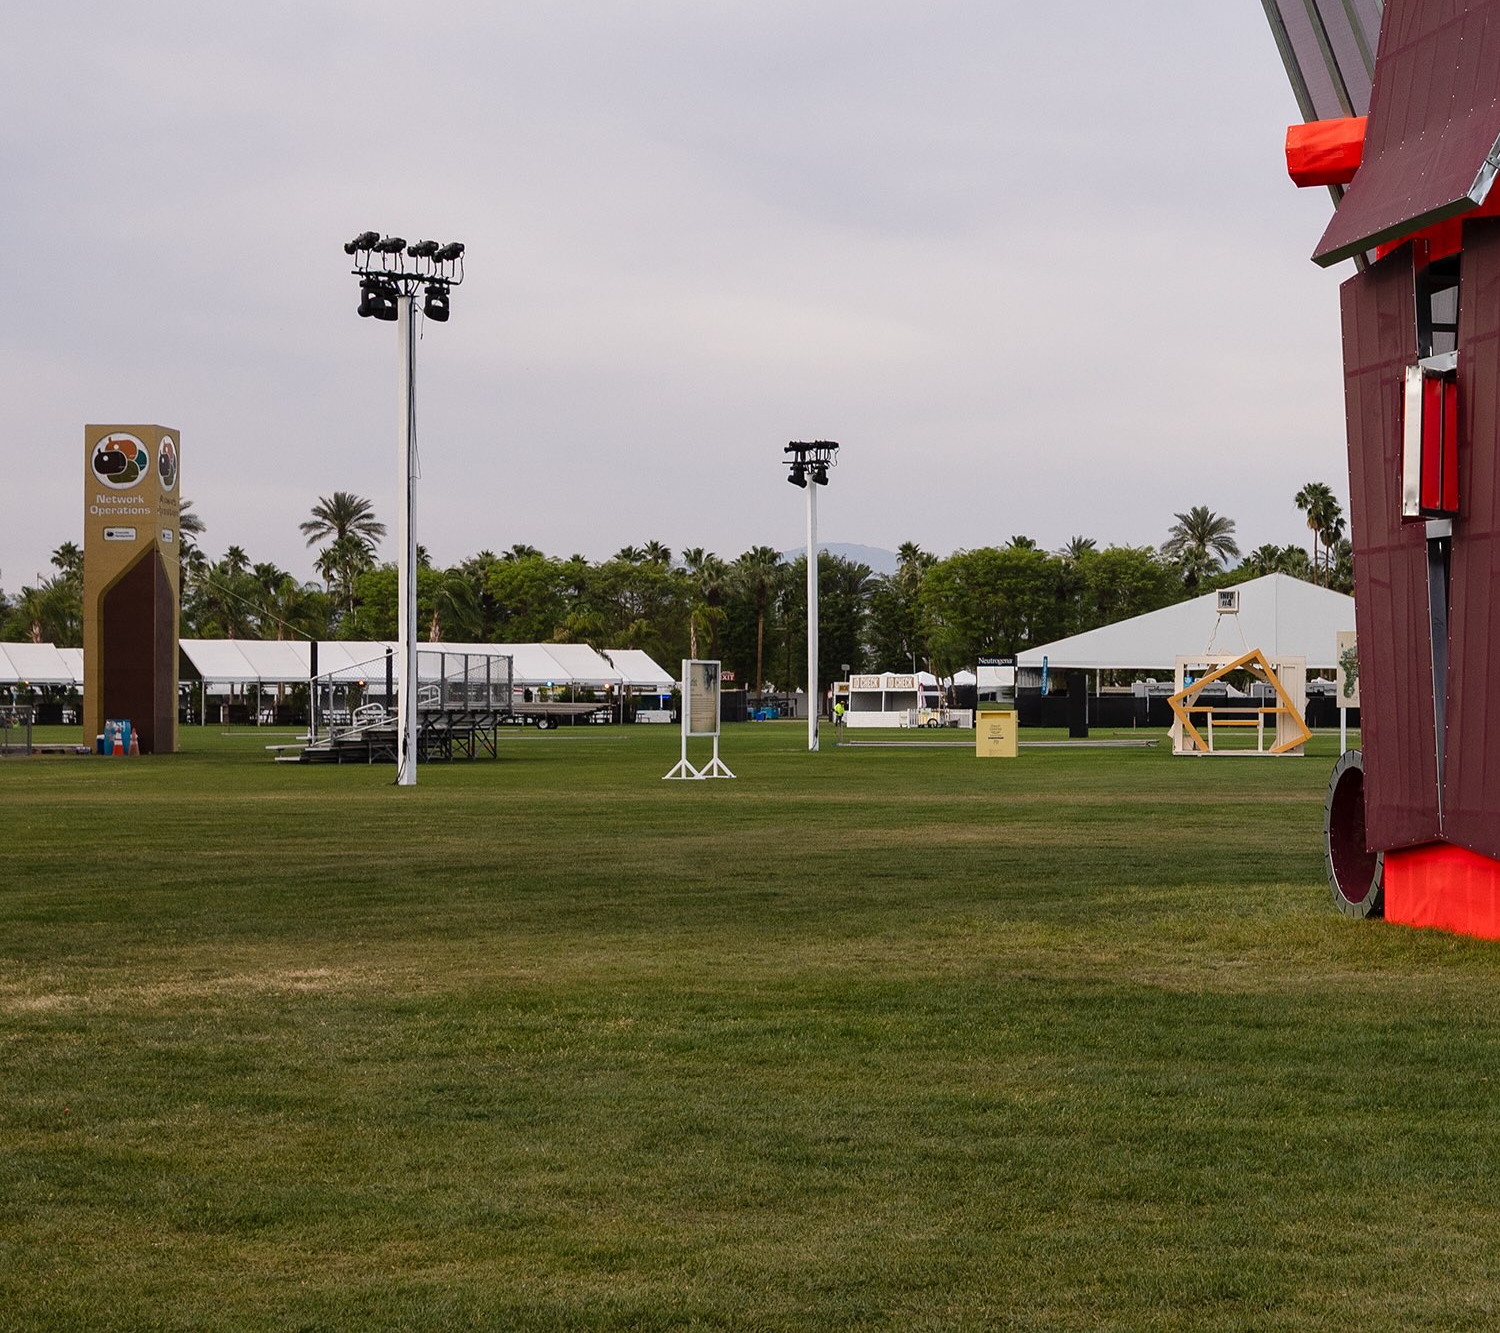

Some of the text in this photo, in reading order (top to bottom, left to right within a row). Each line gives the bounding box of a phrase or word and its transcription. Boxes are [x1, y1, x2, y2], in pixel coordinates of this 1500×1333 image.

[96, 495, 145, 503] Network
[90, 505, 151, 516] Operations
[978, 657, 1013, 665] Neutrogena
[860, 678, 879, 688] CHECK
[895, 677, 914, 688] CHECK
